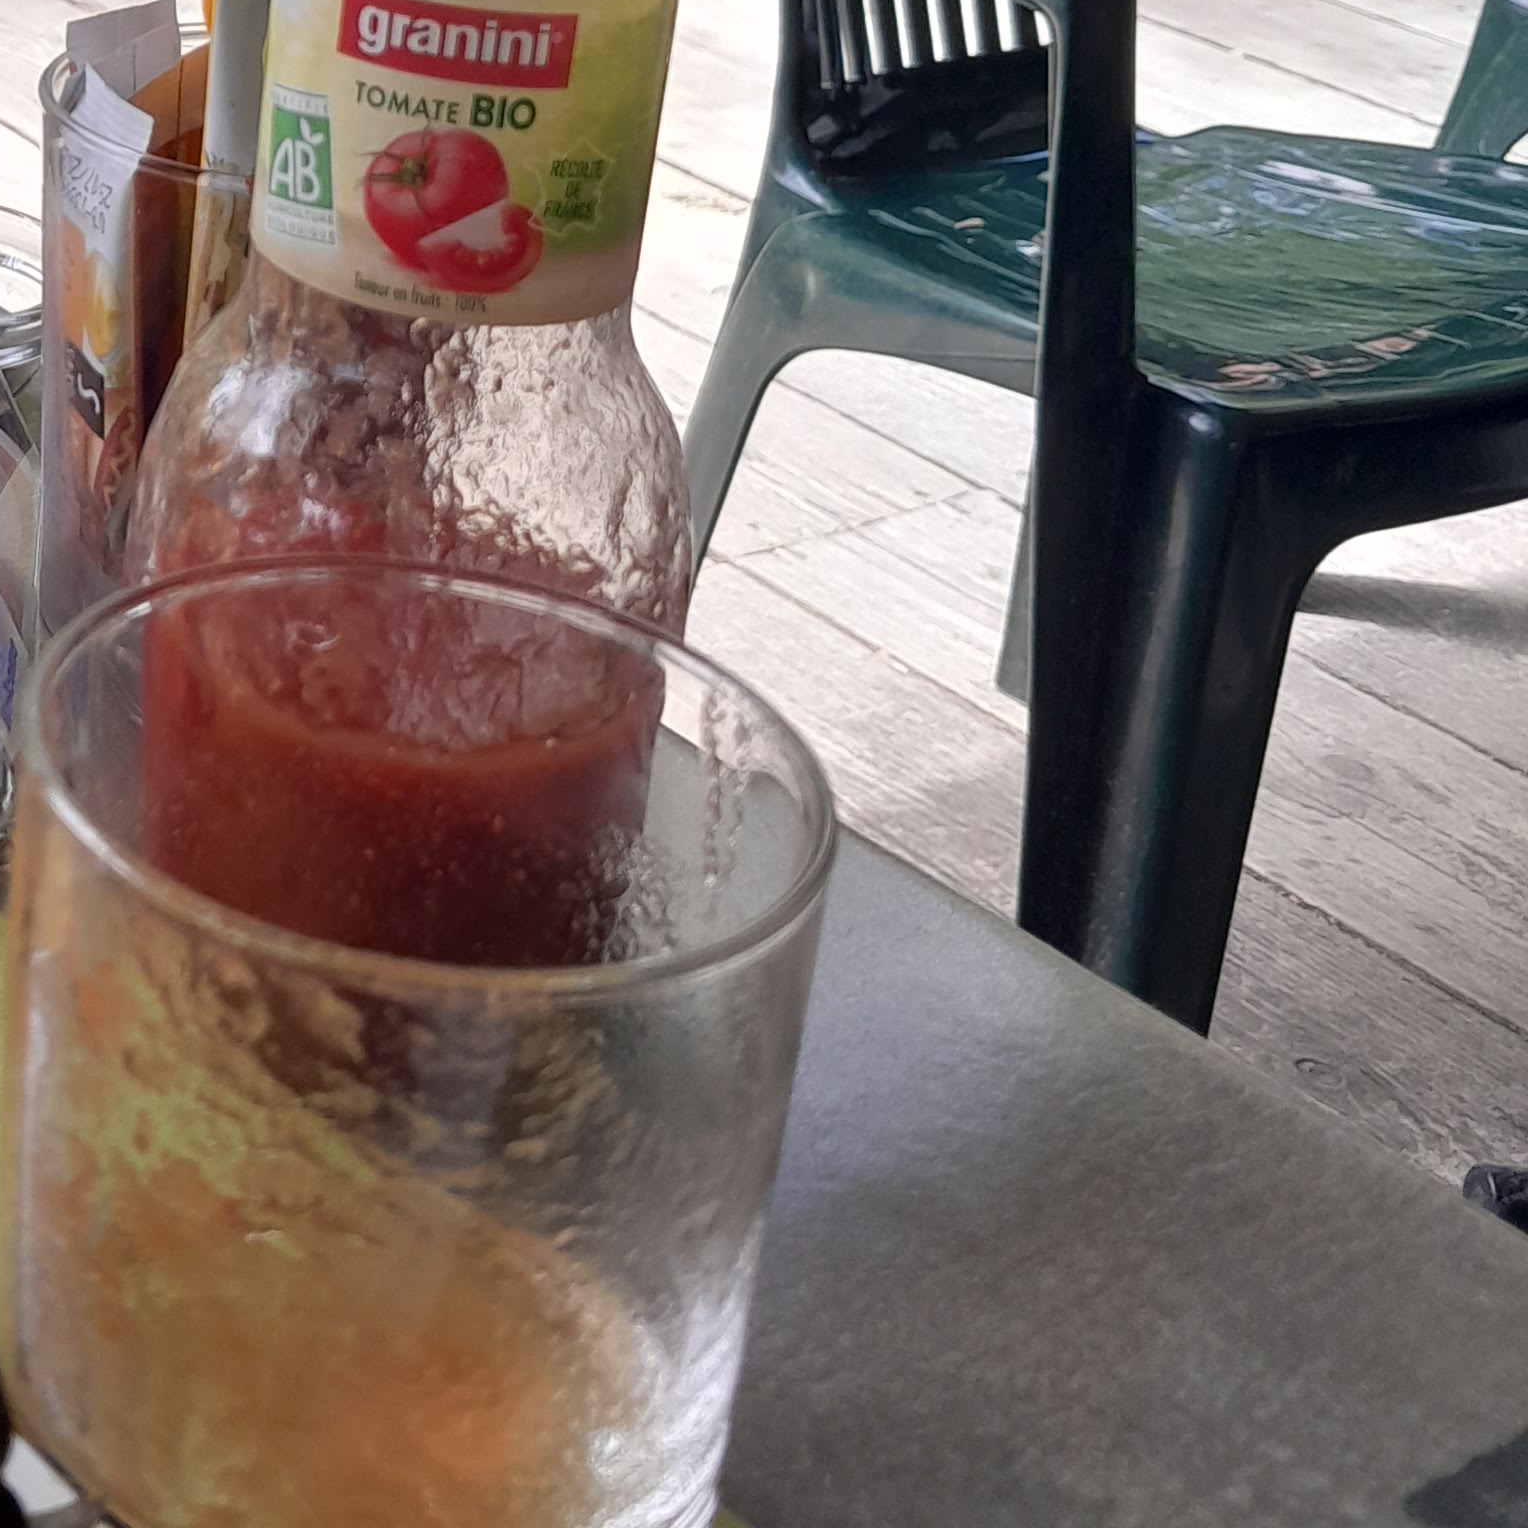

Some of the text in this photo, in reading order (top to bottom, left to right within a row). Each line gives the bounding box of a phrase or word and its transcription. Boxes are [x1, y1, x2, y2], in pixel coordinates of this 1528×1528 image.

[356, 5, 552, 68] granini
[356, 79, 460, 124] TOMATE
[470, 93, 537, 131] BIO
[271, 136, 321, 203] AB
[411, 283, 441, 309] fruits
[455, 293, 488, 313] 100%
